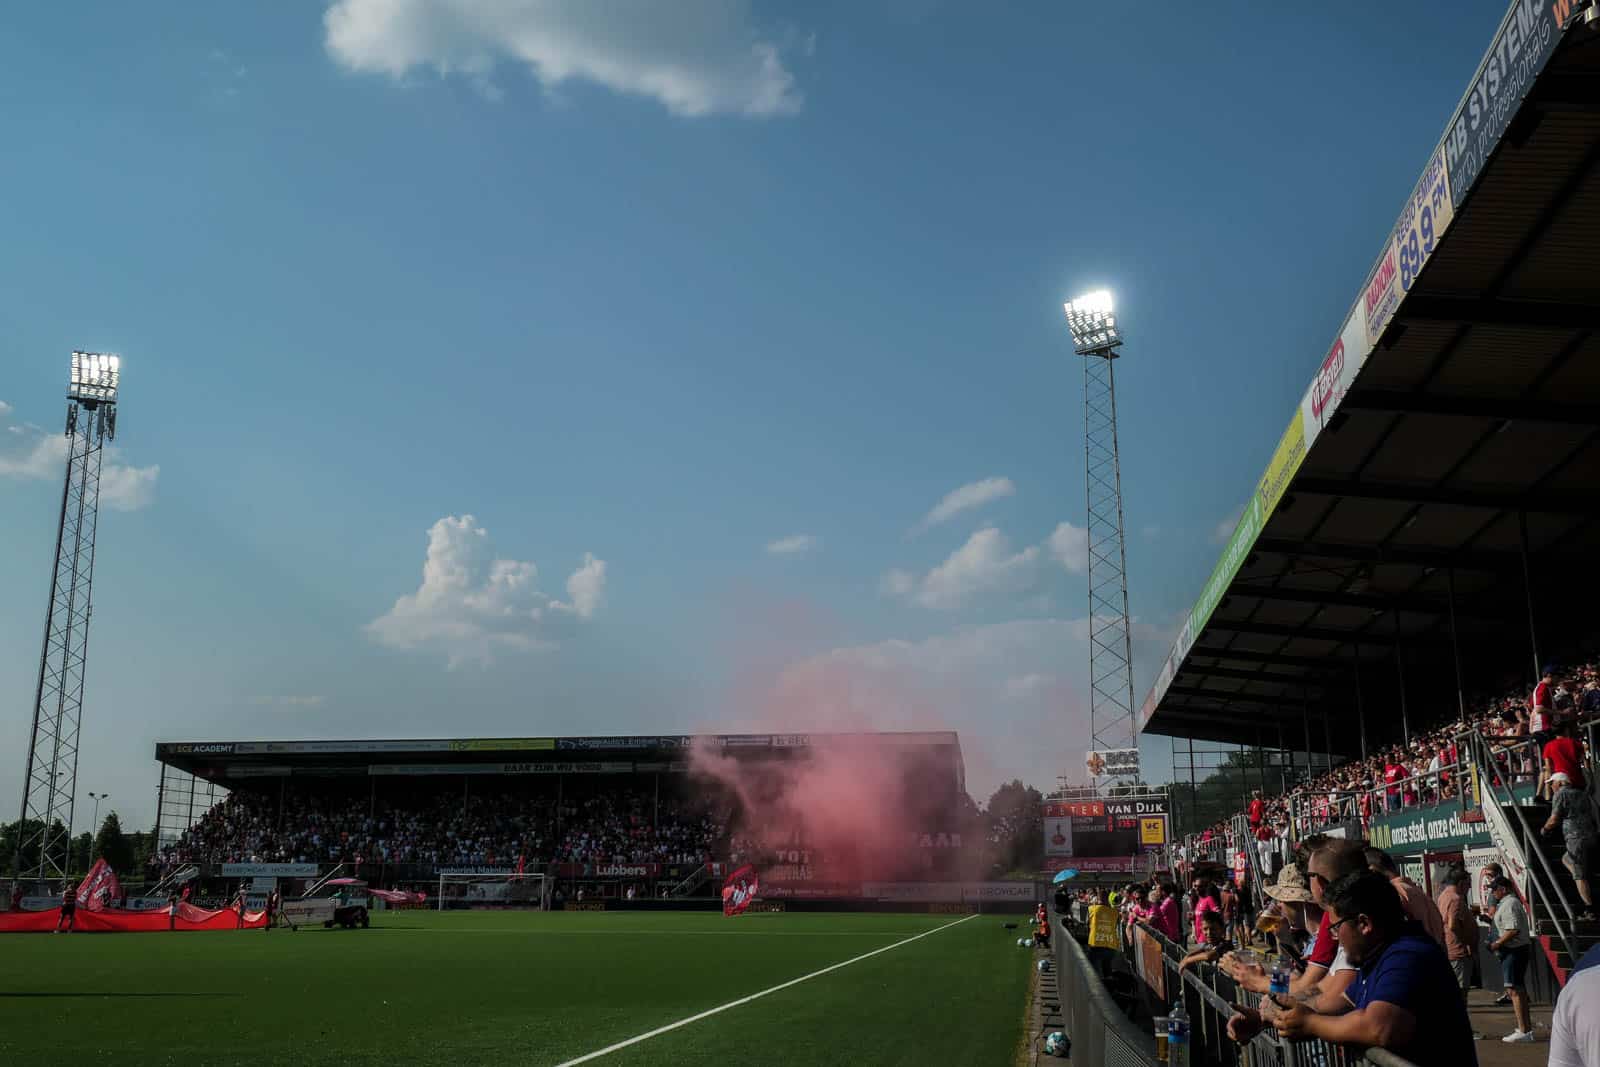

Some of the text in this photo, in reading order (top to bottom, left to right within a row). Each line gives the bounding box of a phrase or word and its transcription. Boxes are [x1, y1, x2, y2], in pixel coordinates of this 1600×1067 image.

[1478, 16, 1551, 165] professionals
[1445, 119, 1467, 170] HB
[1416, 152, 1443, 209] EMMEN
[1399, 175, 1447, 292] 89.9 FM
[193, 744, 233, 753] ACADEMY
[1107, 804, 1132, 814] VAN
[1135, 802, 1163, 813] DIJK
[1391, 827, 1408, 845] onze
[1408, 817, 1428, 845] stad,
[1428, 819, 1448, 840] onze
[596, 864, 647, 876] Lubbers
